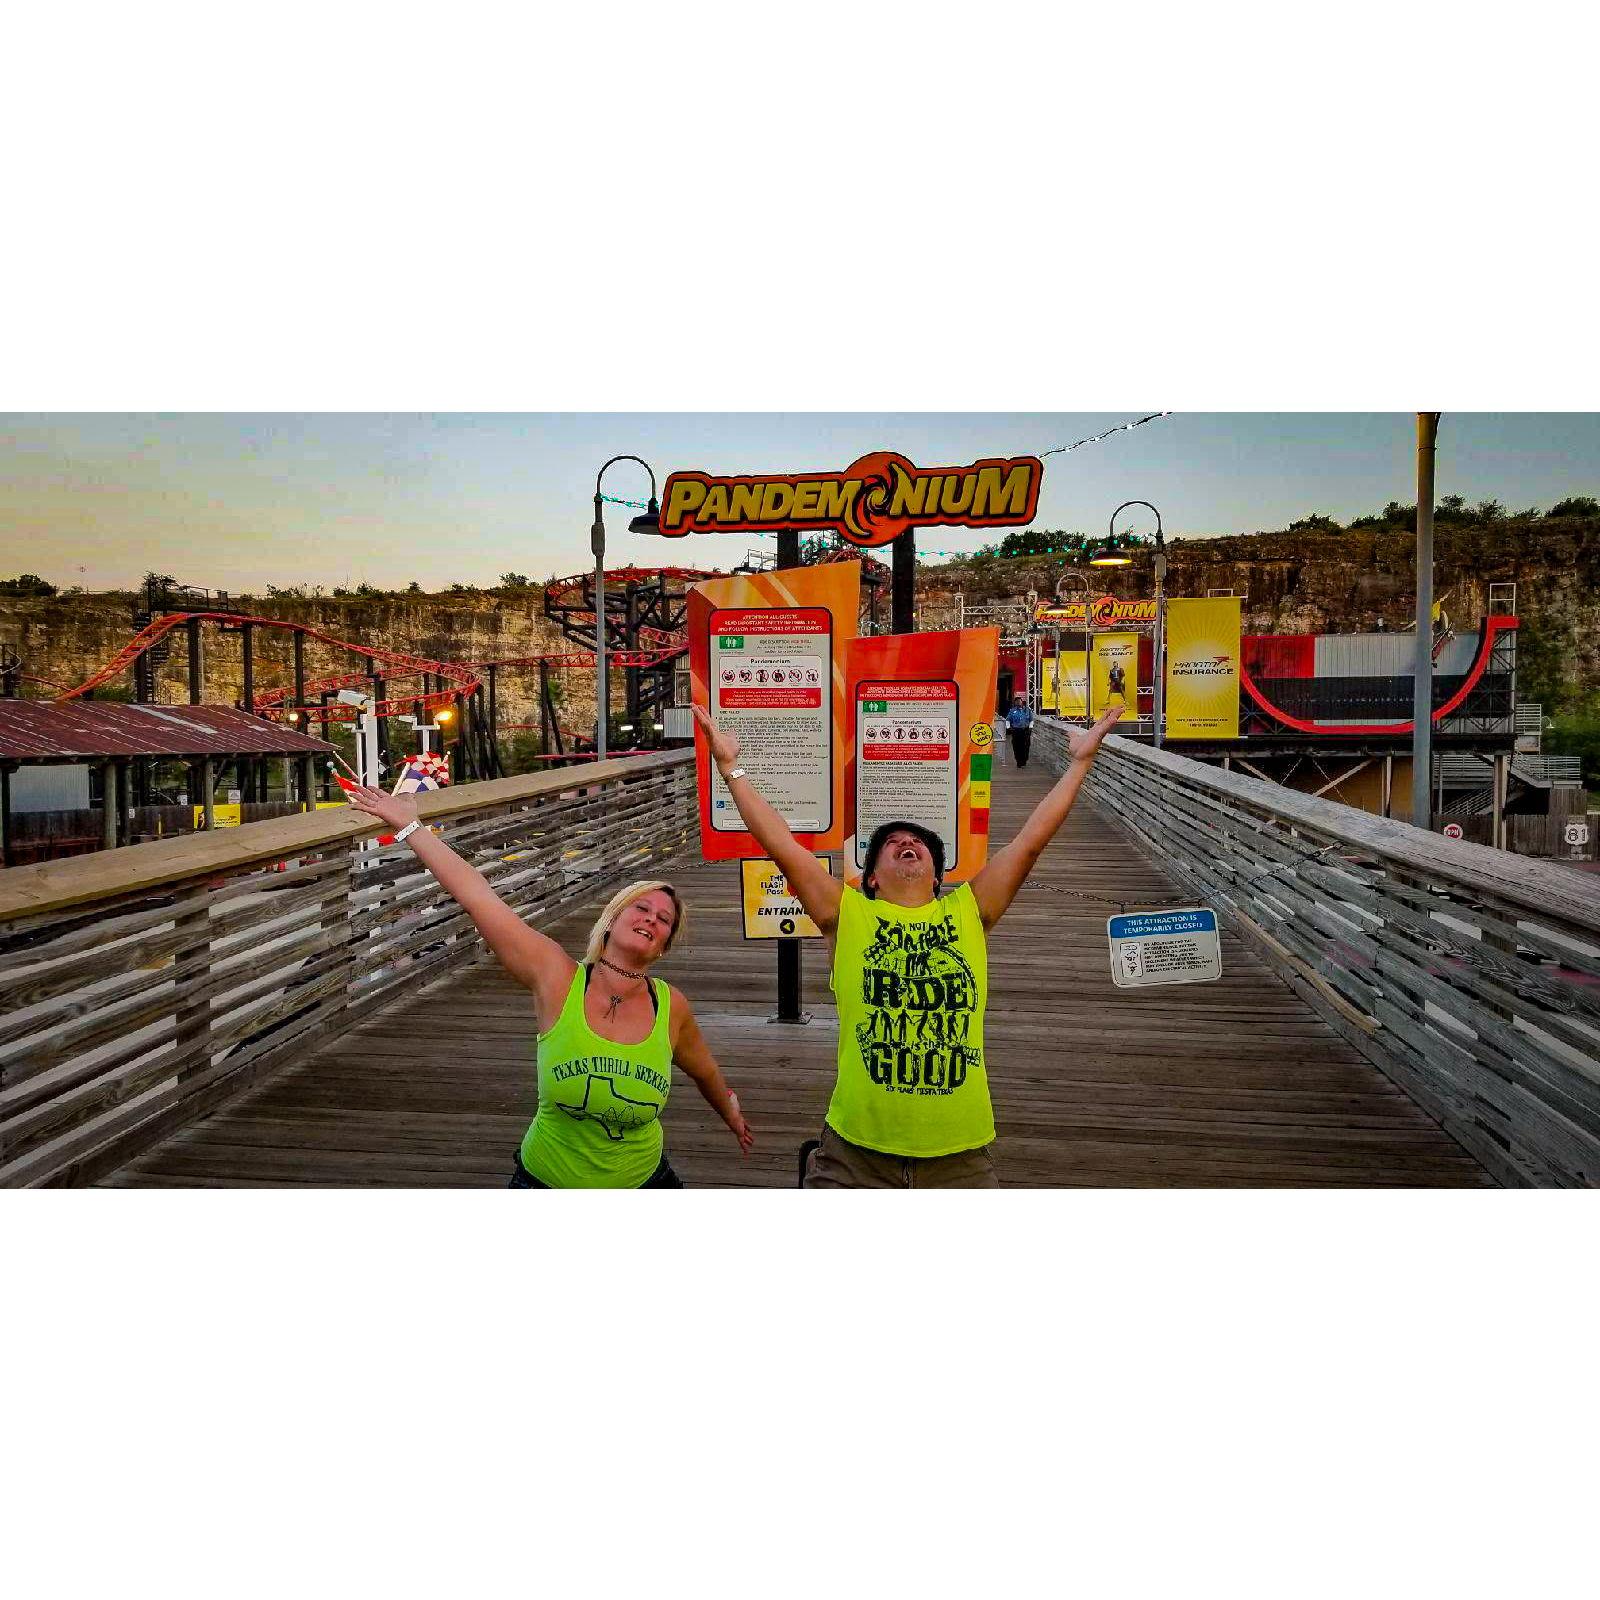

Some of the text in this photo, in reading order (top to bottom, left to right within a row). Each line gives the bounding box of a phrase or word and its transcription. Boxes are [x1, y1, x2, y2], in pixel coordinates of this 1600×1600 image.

[664, 464, 1032, 537] PANDEMONIUM
[1172, 668, 1234, 676] INSURANCE
[1568, 828, 1586, 842] 81
[909, 921, 927, 932] NOT
[1144, 916, 1188, 925] ATTRACTION
[1123, 925, 1172, 934] TEMPORARILY
[863, 966, 969, 1012] RIDE
[552, 1058, 589, 1082] TEXAS
[592, 1056, 631, 1077] THRILL
[869, 1041, 968, 1089] GOOD
